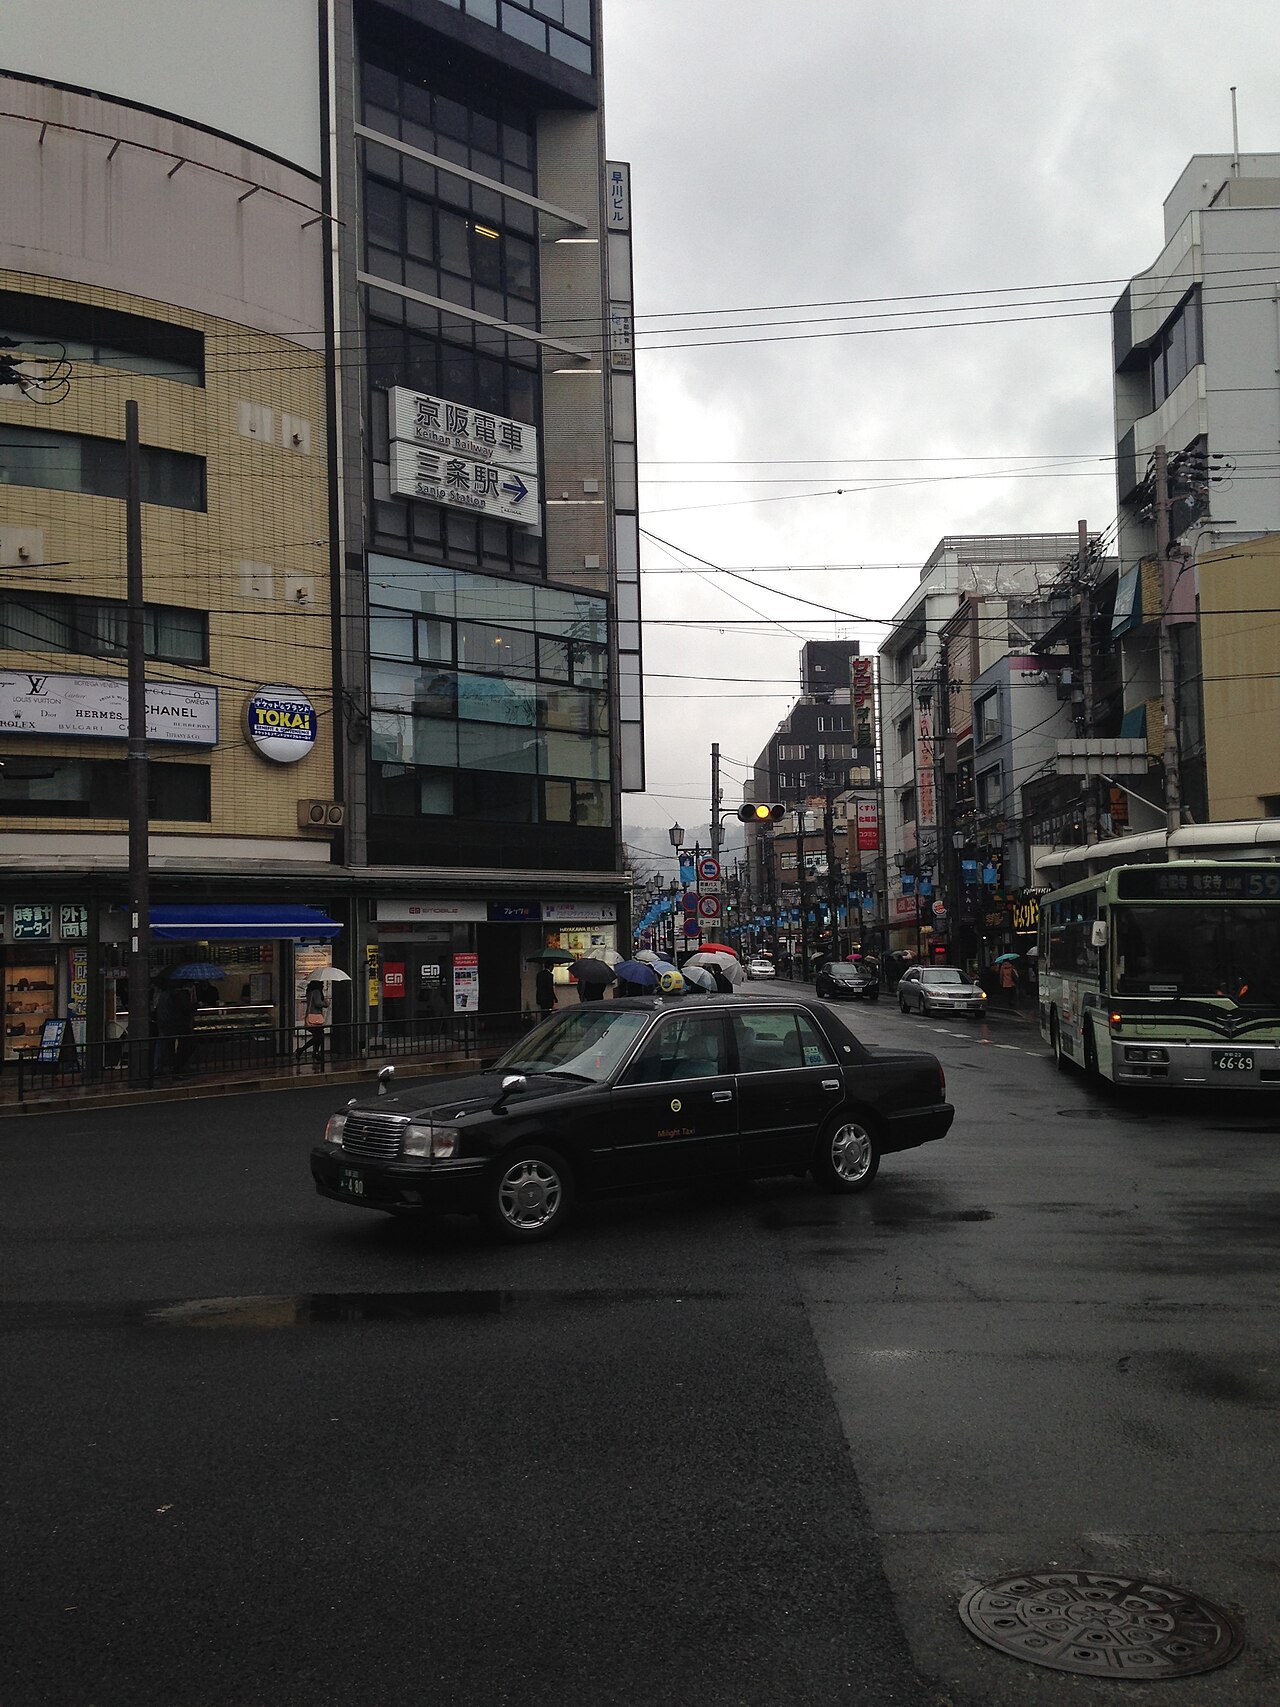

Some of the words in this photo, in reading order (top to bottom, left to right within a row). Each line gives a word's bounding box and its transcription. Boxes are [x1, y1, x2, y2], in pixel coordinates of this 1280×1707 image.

[611, 171, 624, 221] 早川ビル
[414, 397, 523, 449] 京阪電車
[415, 427, 450, 445] Keihan
[455, 439, 494, 458] Railway
[417, 451, 500, 497] 三条駅
[417, 482, 446, 497] Sanjo
[450, 491, 486, 507] Station
[185, 698, 210, 706] OMEGA
[0, 721, 36, 729] ROLEX
[58, 724, 103, 732] BVLGARI
[255, 708, 310, 730] TOKAI
[1249, 874, 1279, 895] 59
[15, 907, 50, 922] 時計
[15, 922, 50, 937] ケータイ
[1219, 1057, 1253, 1070] 66-69
[682, 1127, 696, 1135] Taxi
